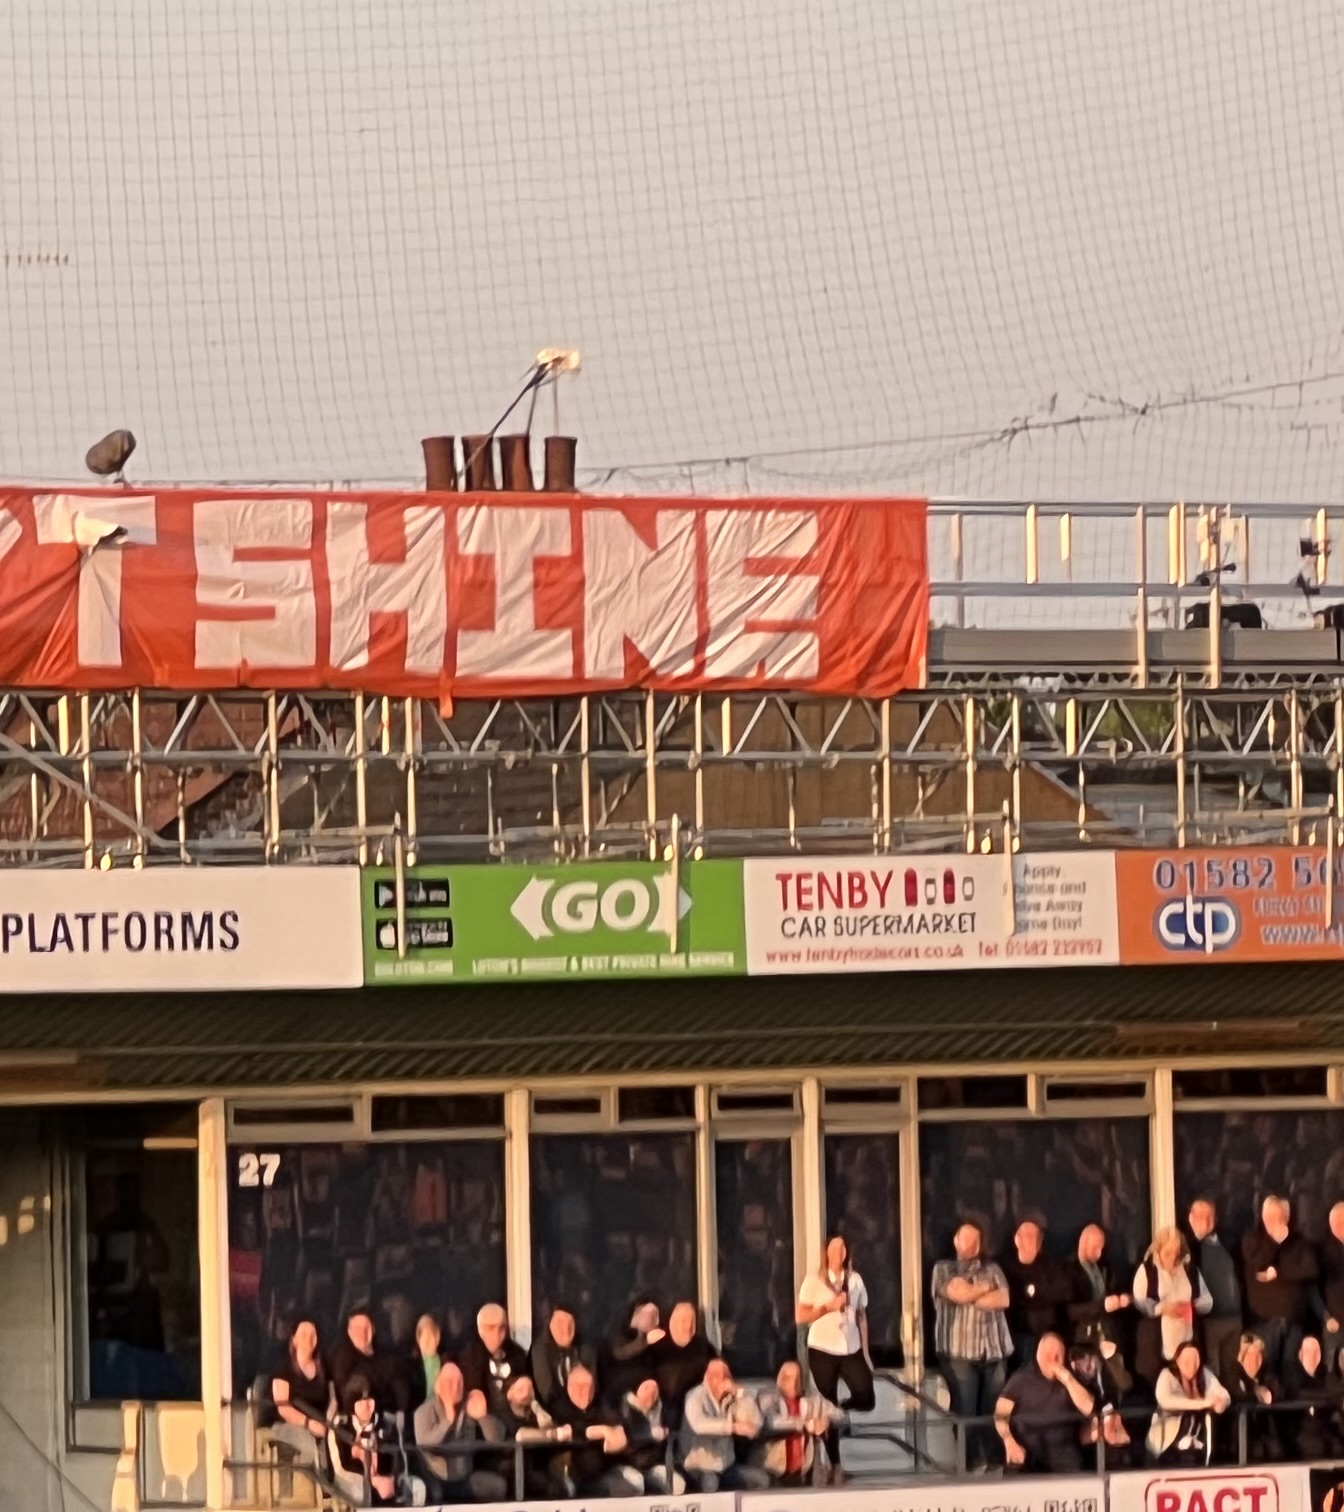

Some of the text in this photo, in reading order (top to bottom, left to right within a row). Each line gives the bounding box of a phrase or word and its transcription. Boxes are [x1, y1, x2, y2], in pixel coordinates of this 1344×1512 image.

[192, 499, 820, 680] SHINE
[775, 868, 893, 912] TENBY
[1155, 857, 1274, 890] 01582
[552, 879, 650, 933] GO
[781, 911, 977, 938] CAR SUPERMARKET
[4, 909, 240, 954] PLATFORMS
[238, 1152, 281, 1187] 27
